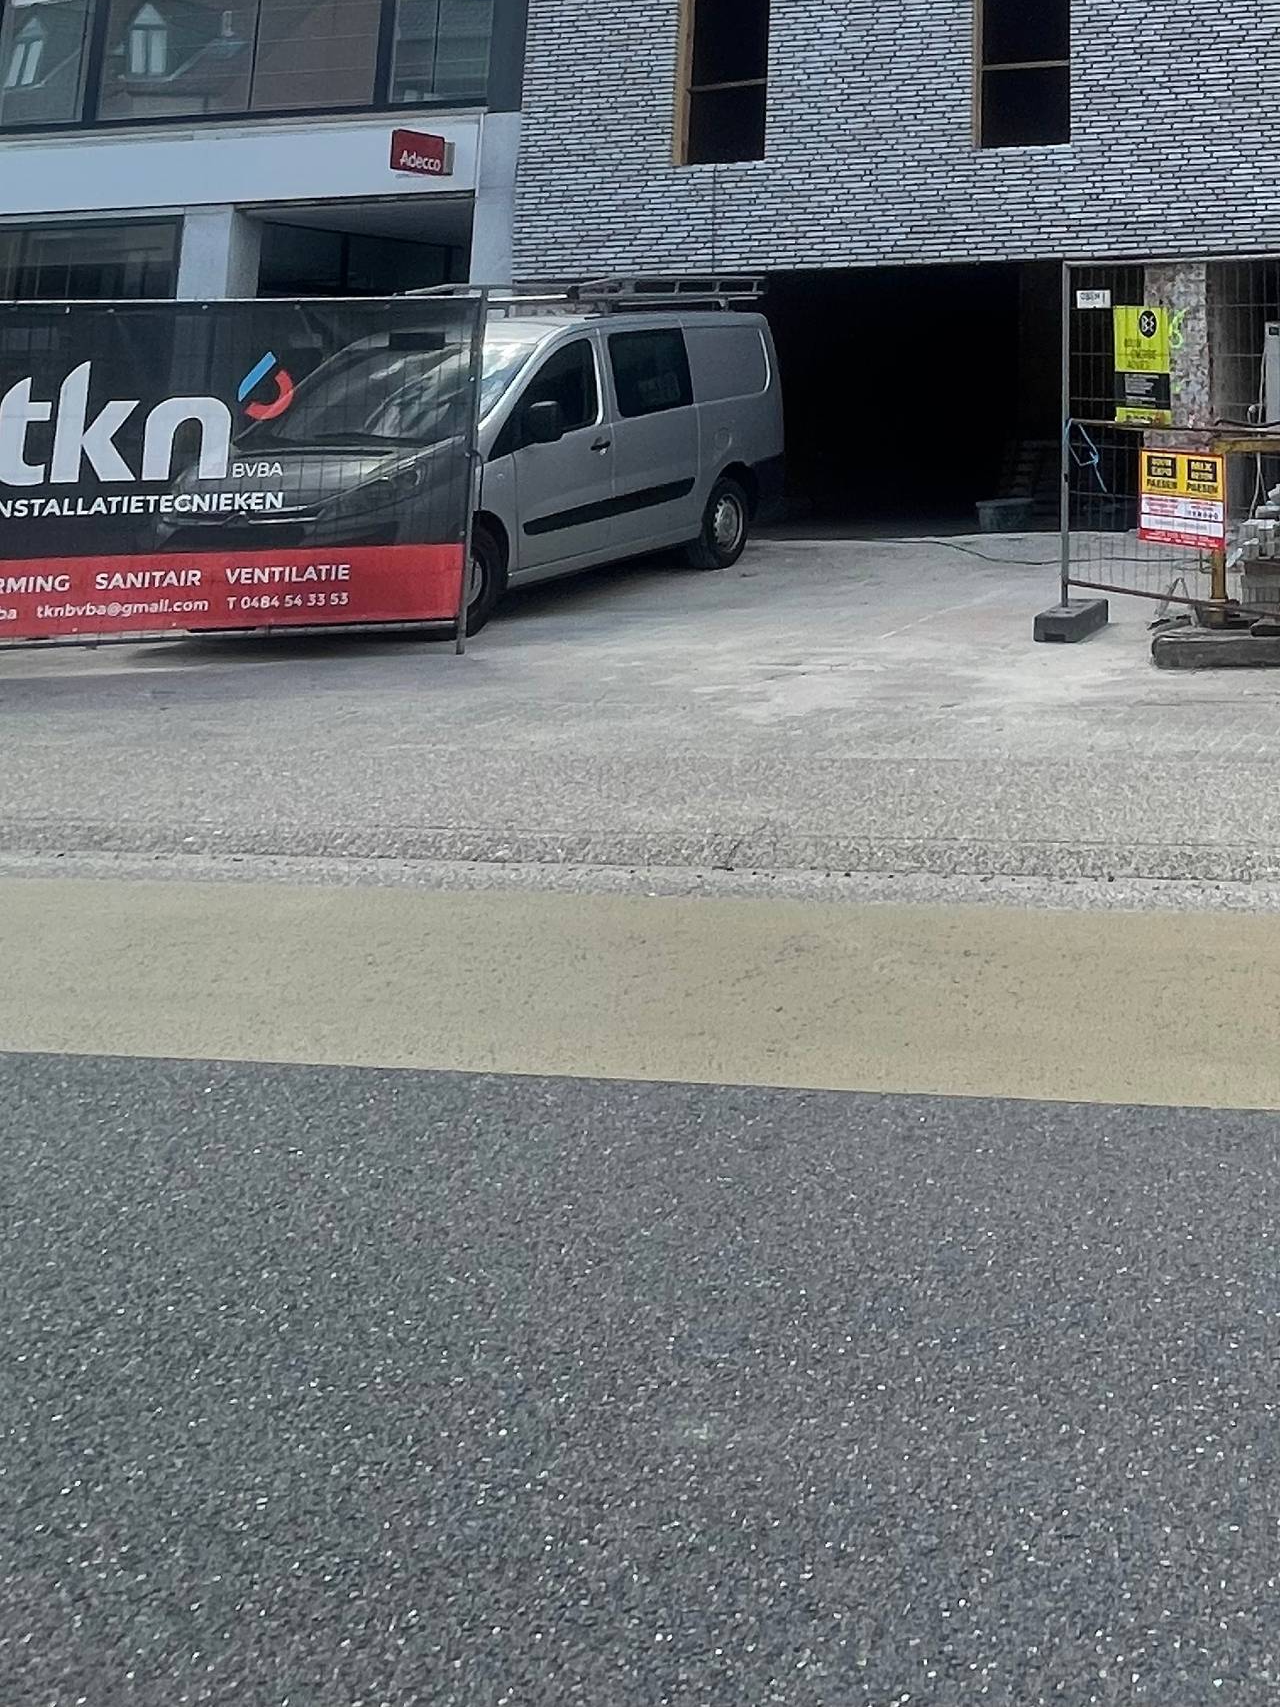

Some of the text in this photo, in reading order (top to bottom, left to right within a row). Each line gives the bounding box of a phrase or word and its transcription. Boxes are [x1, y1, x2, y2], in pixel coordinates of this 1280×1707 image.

[400, 149, 442, 171] Adecco
[0, 360, 232, 487] tkn
[232, 462, 283, 479] BVBA
[95, 570, 202, 590] SANITAIR
[225, 564, 351, 584] VENTILATIE
[37, 599, 209, 619] tknbvba@gmail.com
[227, 597, 237, 610] T
[241, 595, 280, 610] 0484
[284, 594, 303, 607] 54
[306, 593, 326, 607] 33
[330, 592, 350, 606] 53
